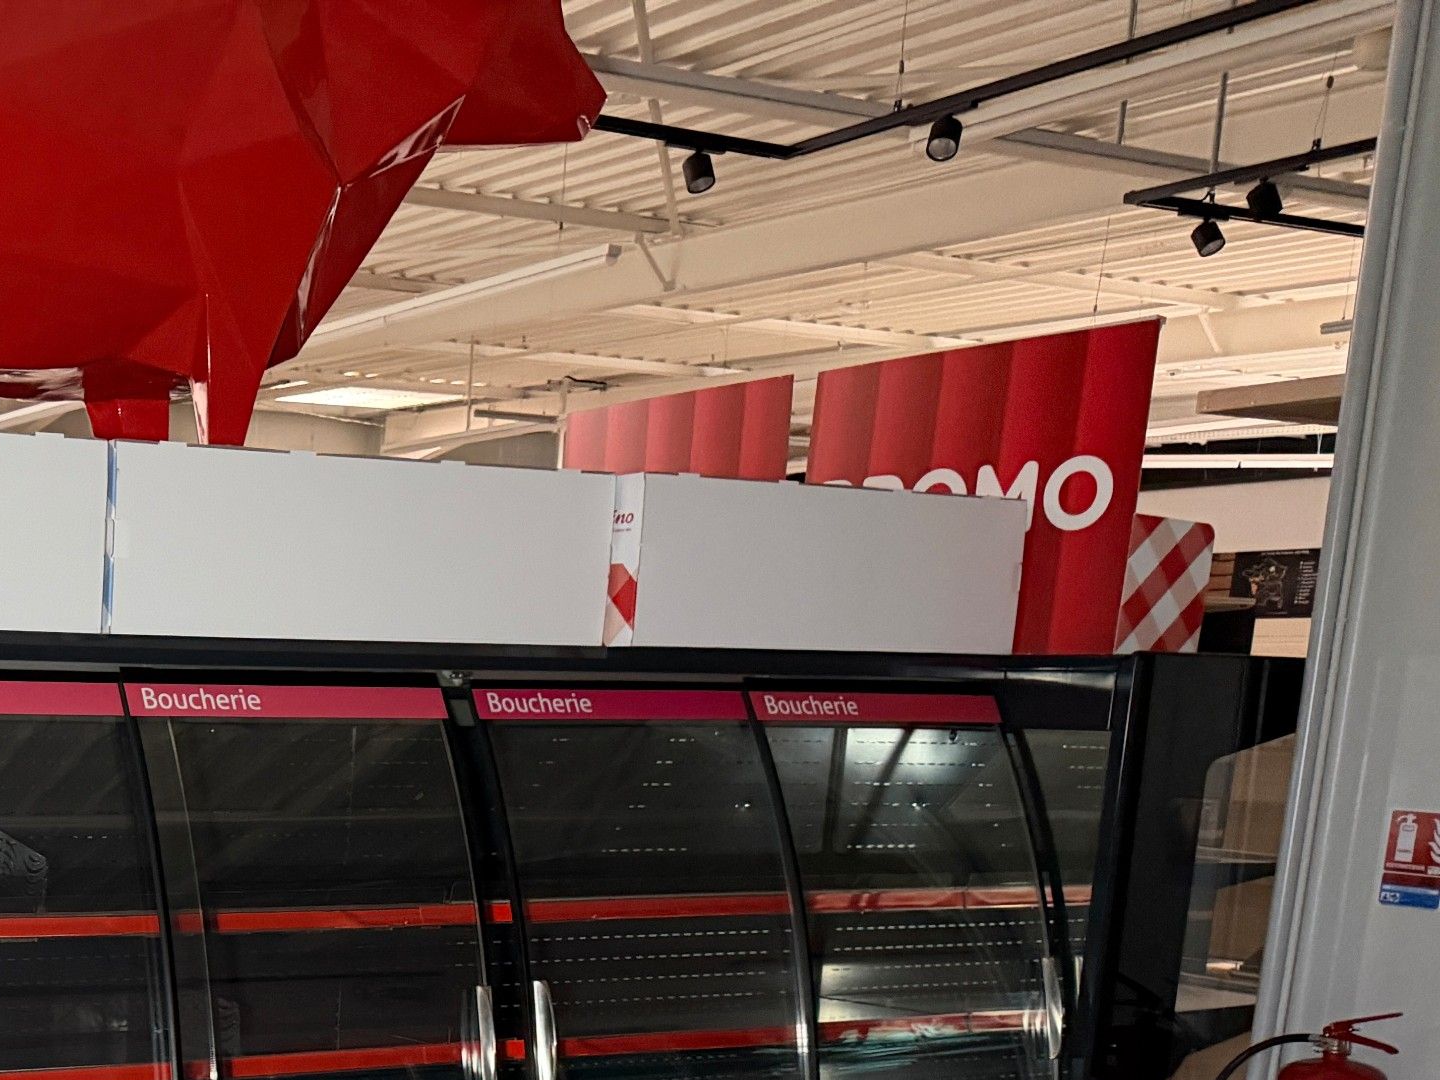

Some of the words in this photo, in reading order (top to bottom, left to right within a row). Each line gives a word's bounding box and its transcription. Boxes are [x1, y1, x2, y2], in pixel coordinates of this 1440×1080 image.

[141, 687, 261, 710] Boucherie
[486, 692, 593, 713] Boucherie
[764, 695, 859, 715] Boucherie
